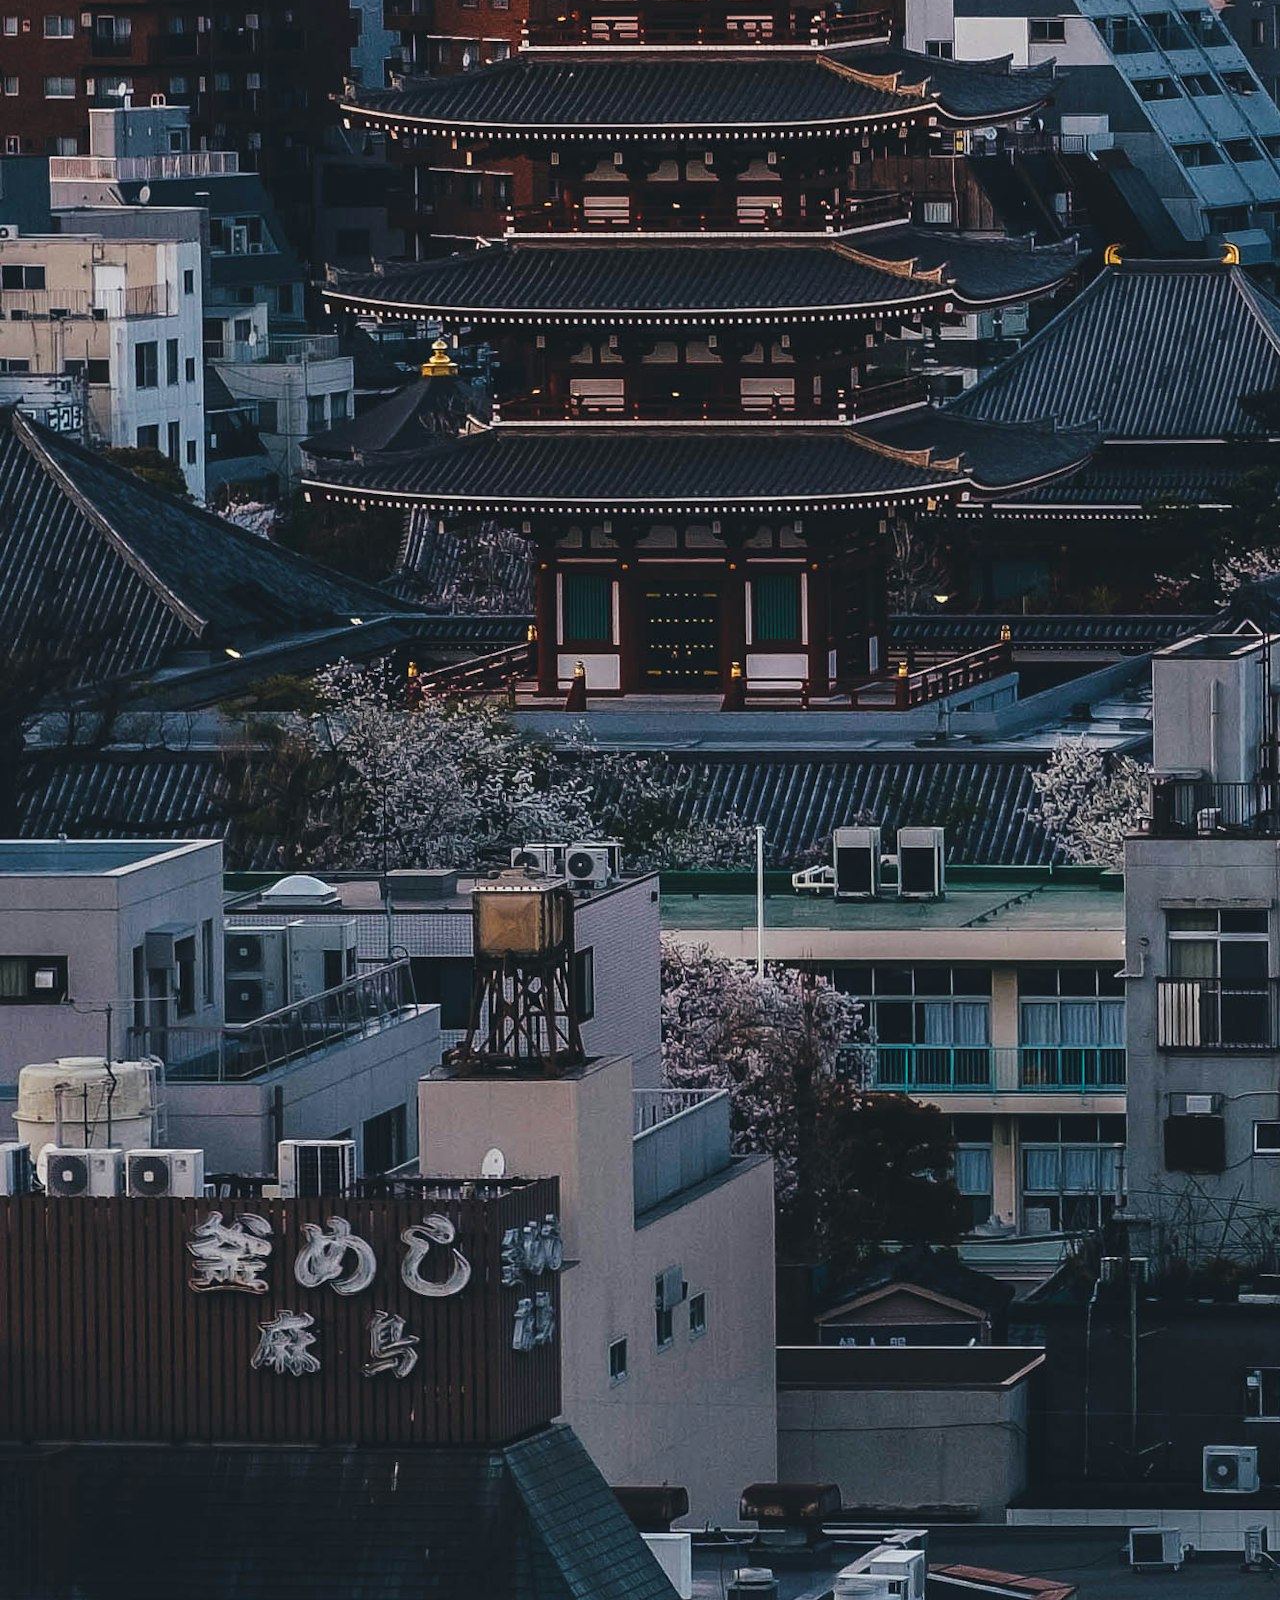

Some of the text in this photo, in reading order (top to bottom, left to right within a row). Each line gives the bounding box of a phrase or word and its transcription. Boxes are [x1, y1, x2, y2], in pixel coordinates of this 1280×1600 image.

[186, 1211, 470, 1296] 釜めし
[251, 1309, 421, 1379] 麻鳥
